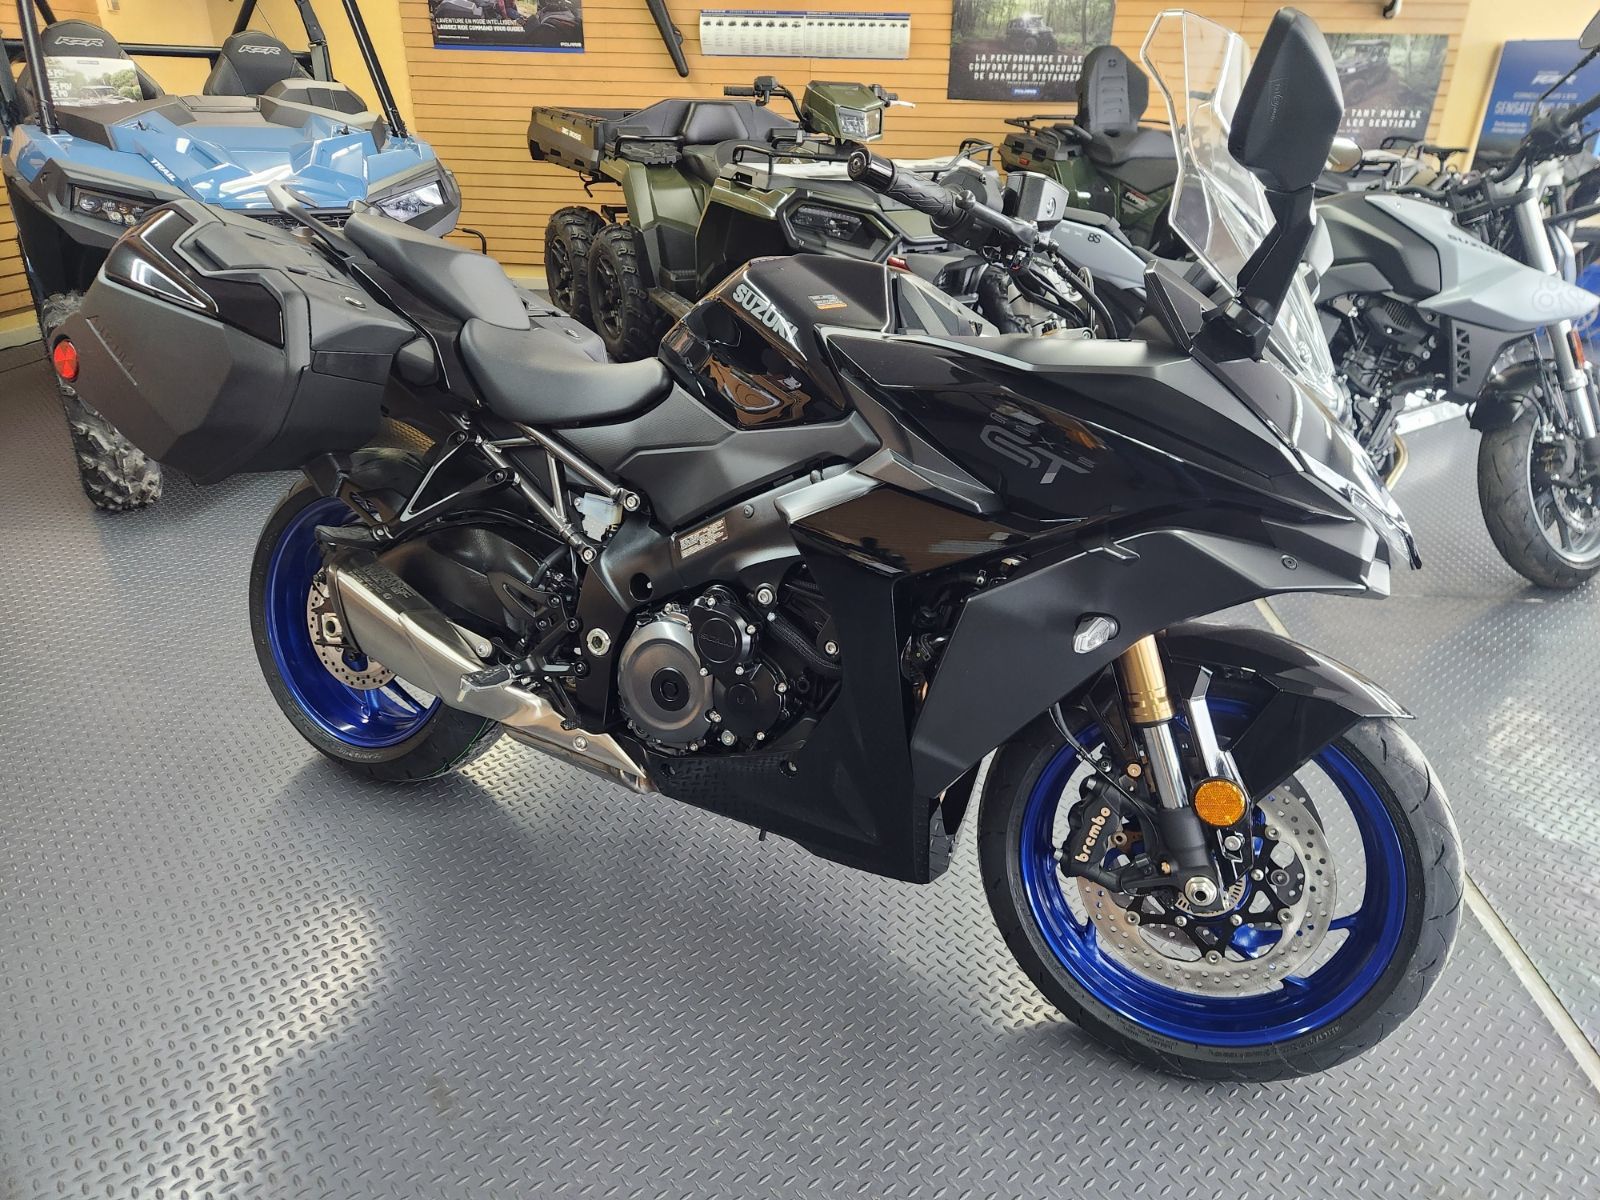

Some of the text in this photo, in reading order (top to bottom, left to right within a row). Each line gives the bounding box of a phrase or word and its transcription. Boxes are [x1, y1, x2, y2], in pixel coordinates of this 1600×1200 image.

[54, 36, 105, 47] RZR
[238, 44, 282, 55] RZR
[990, 54, 1053, 63] PERFORMANCE
[969, 63, 1008, 71] CONFORT
[1012, 64, 1034, 72] POUR
[974, 72, 984, 80] DE
[988, 72, 1028, 80] GRANDES
[1352, 108, 1422, 118] TANT POUR LE
[1346, 119, 1416, 128] LES SENTIERS
[151, 158, 176, 181] TRAIL
[1088, 233, 1101, 243] 8S
[732, 283, 799, 342] SUZUKI
[1075, 807, 1111, 862] brembo
